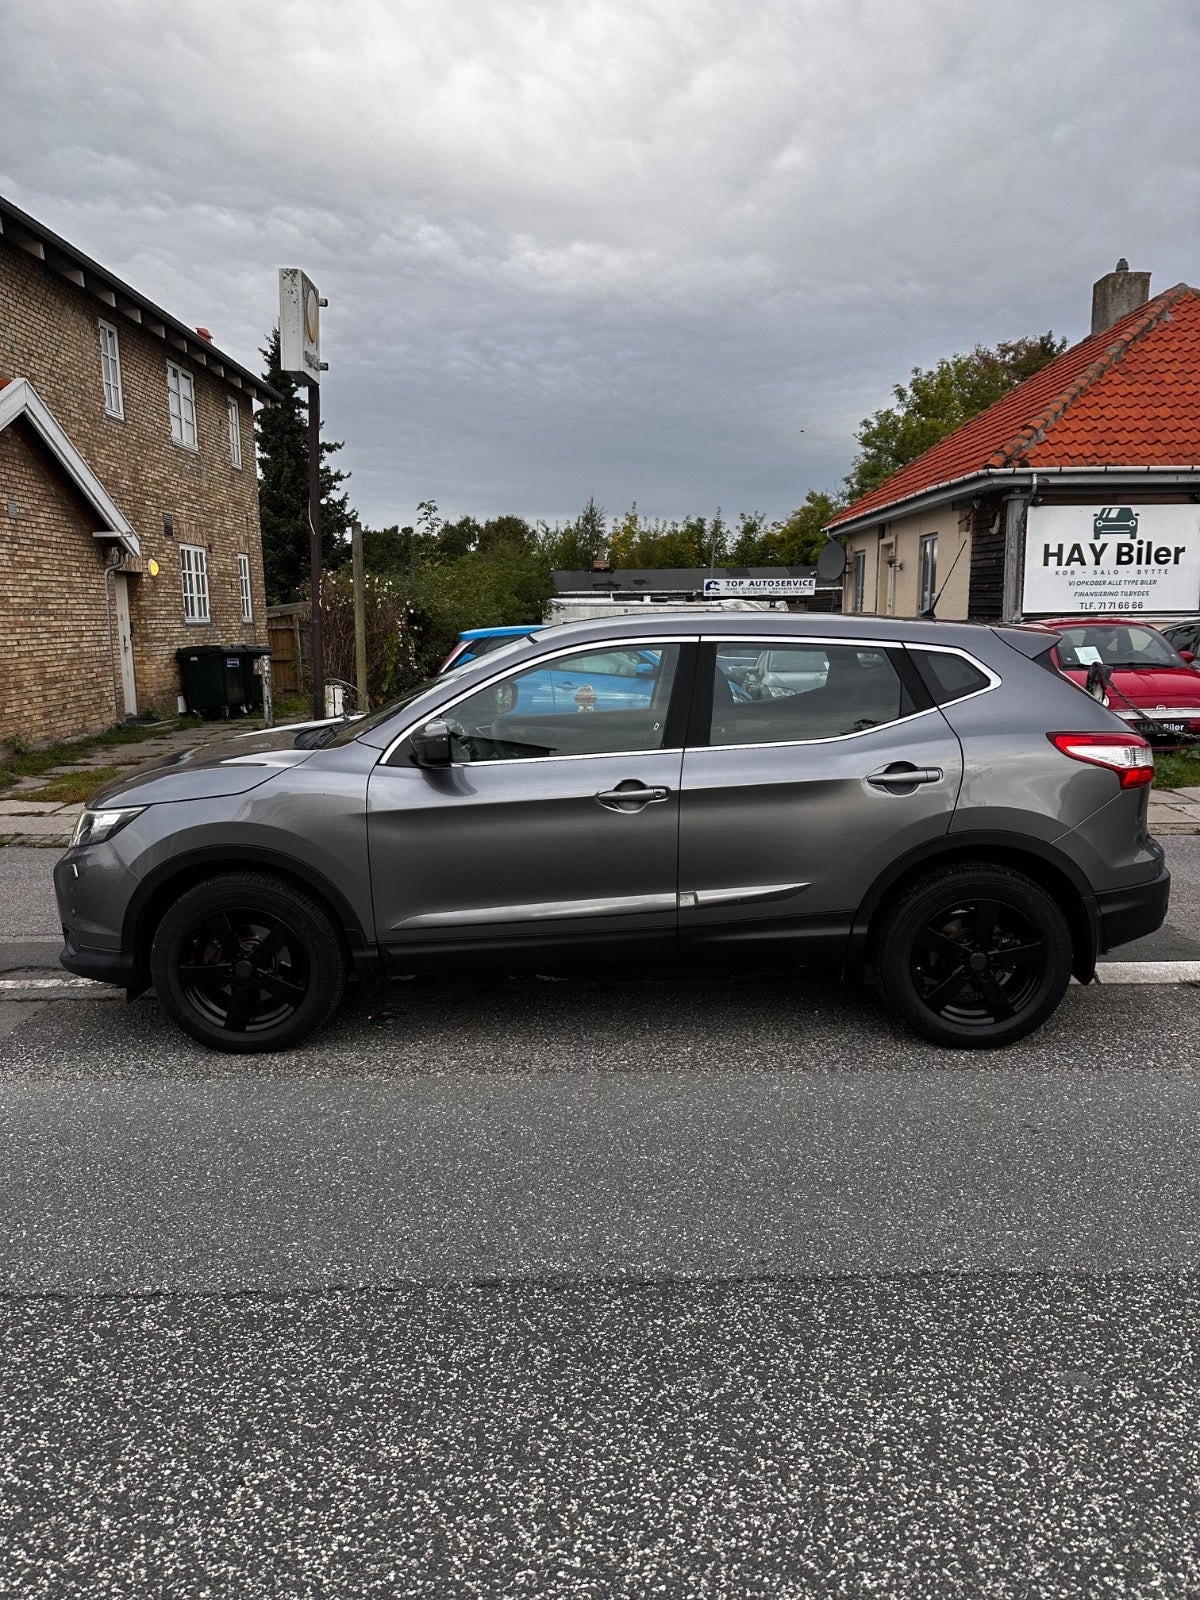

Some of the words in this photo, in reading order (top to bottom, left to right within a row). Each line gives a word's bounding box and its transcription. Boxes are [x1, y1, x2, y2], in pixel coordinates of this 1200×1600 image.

[1042, 542, 1109, 567] HAY
[1116, 539, 1186, 566] Biler
[749, 579, 814, 587] AUTOSERVICE
[1079, 602, 1096, 610] TLF.
[1098, 602, 1106, 610] 71
[1108, 602, 1116, 610] 71
[1118, 601, 1130, 609] 66
[1132, 601, 1144, 609] 66
